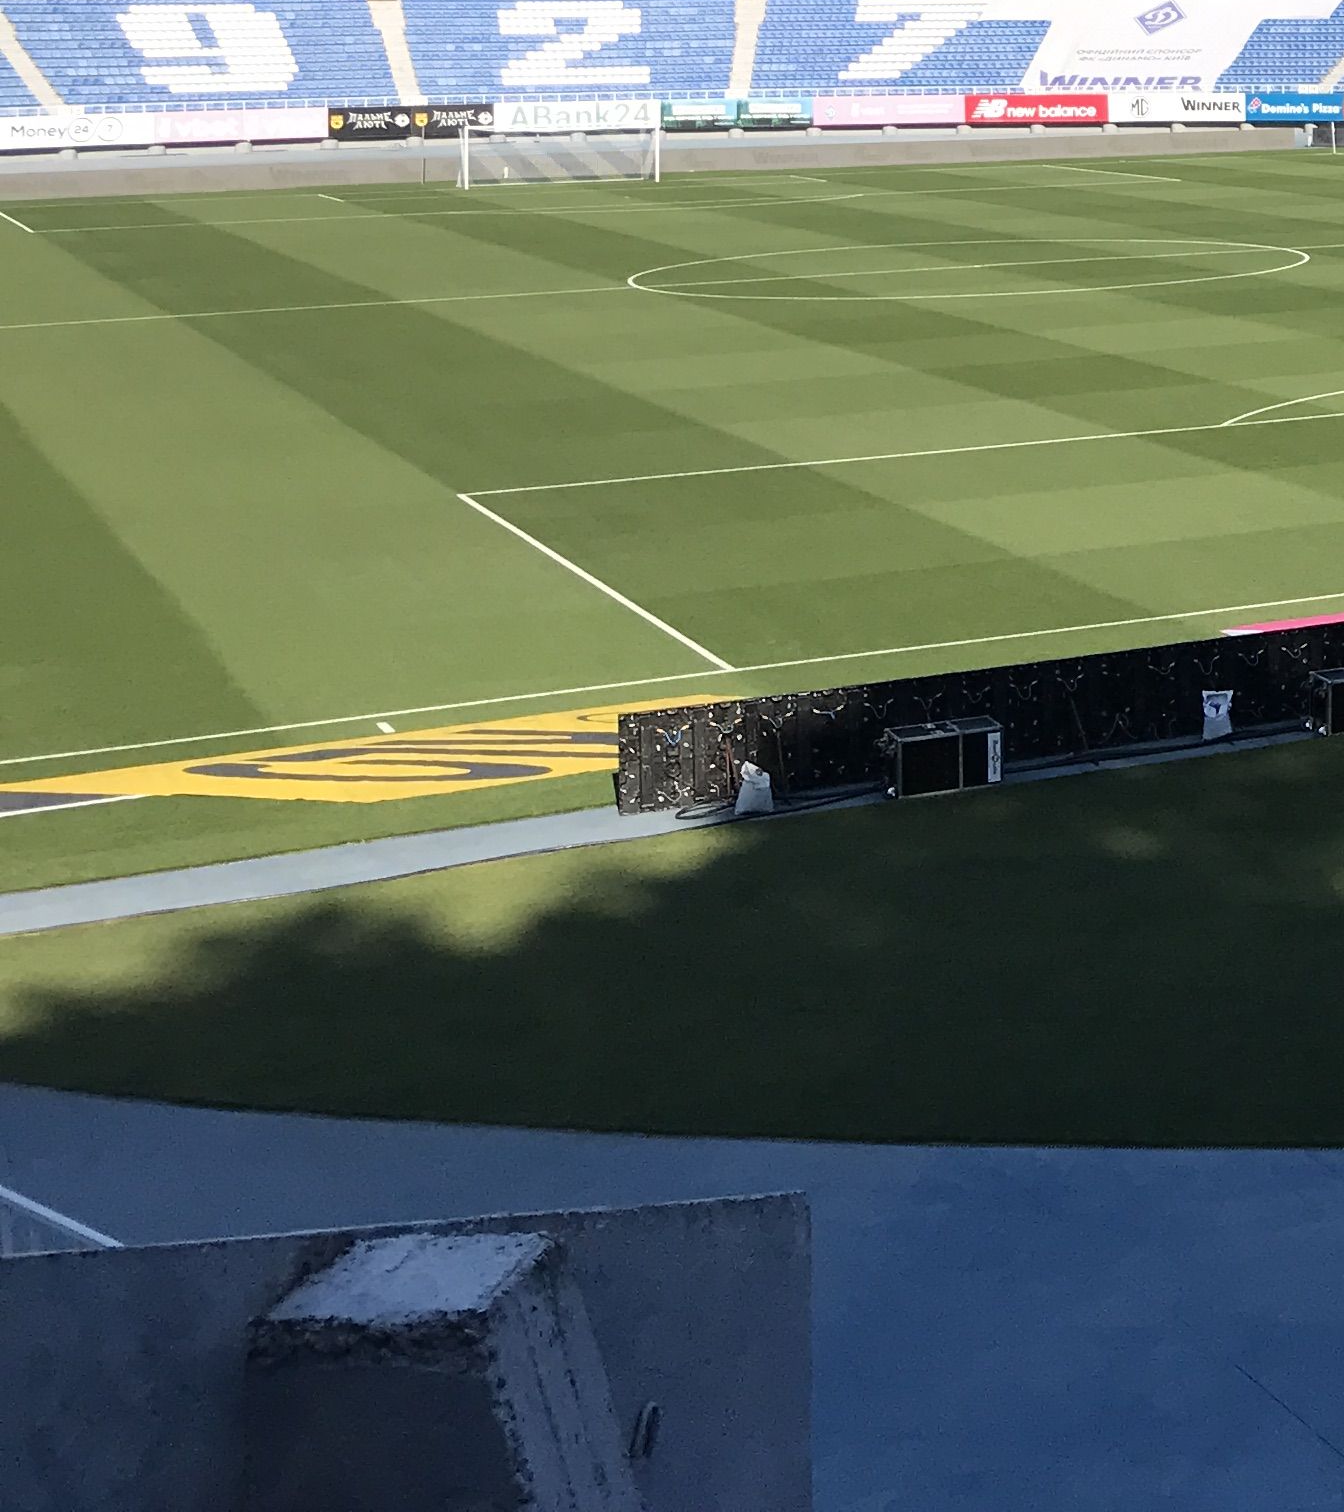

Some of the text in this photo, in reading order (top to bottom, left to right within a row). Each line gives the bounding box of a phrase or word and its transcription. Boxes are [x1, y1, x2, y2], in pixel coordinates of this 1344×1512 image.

[1040, 70, 1202, 91] WINNER
[1007, 108, 1037, 118] new
[1039, 103, 1096, 117] balance
[1181, 97, 1242, 114] WINNER
[1261, 102, 1341, 114] Domino's Pizza
[11, 124, 66, 138] Money
